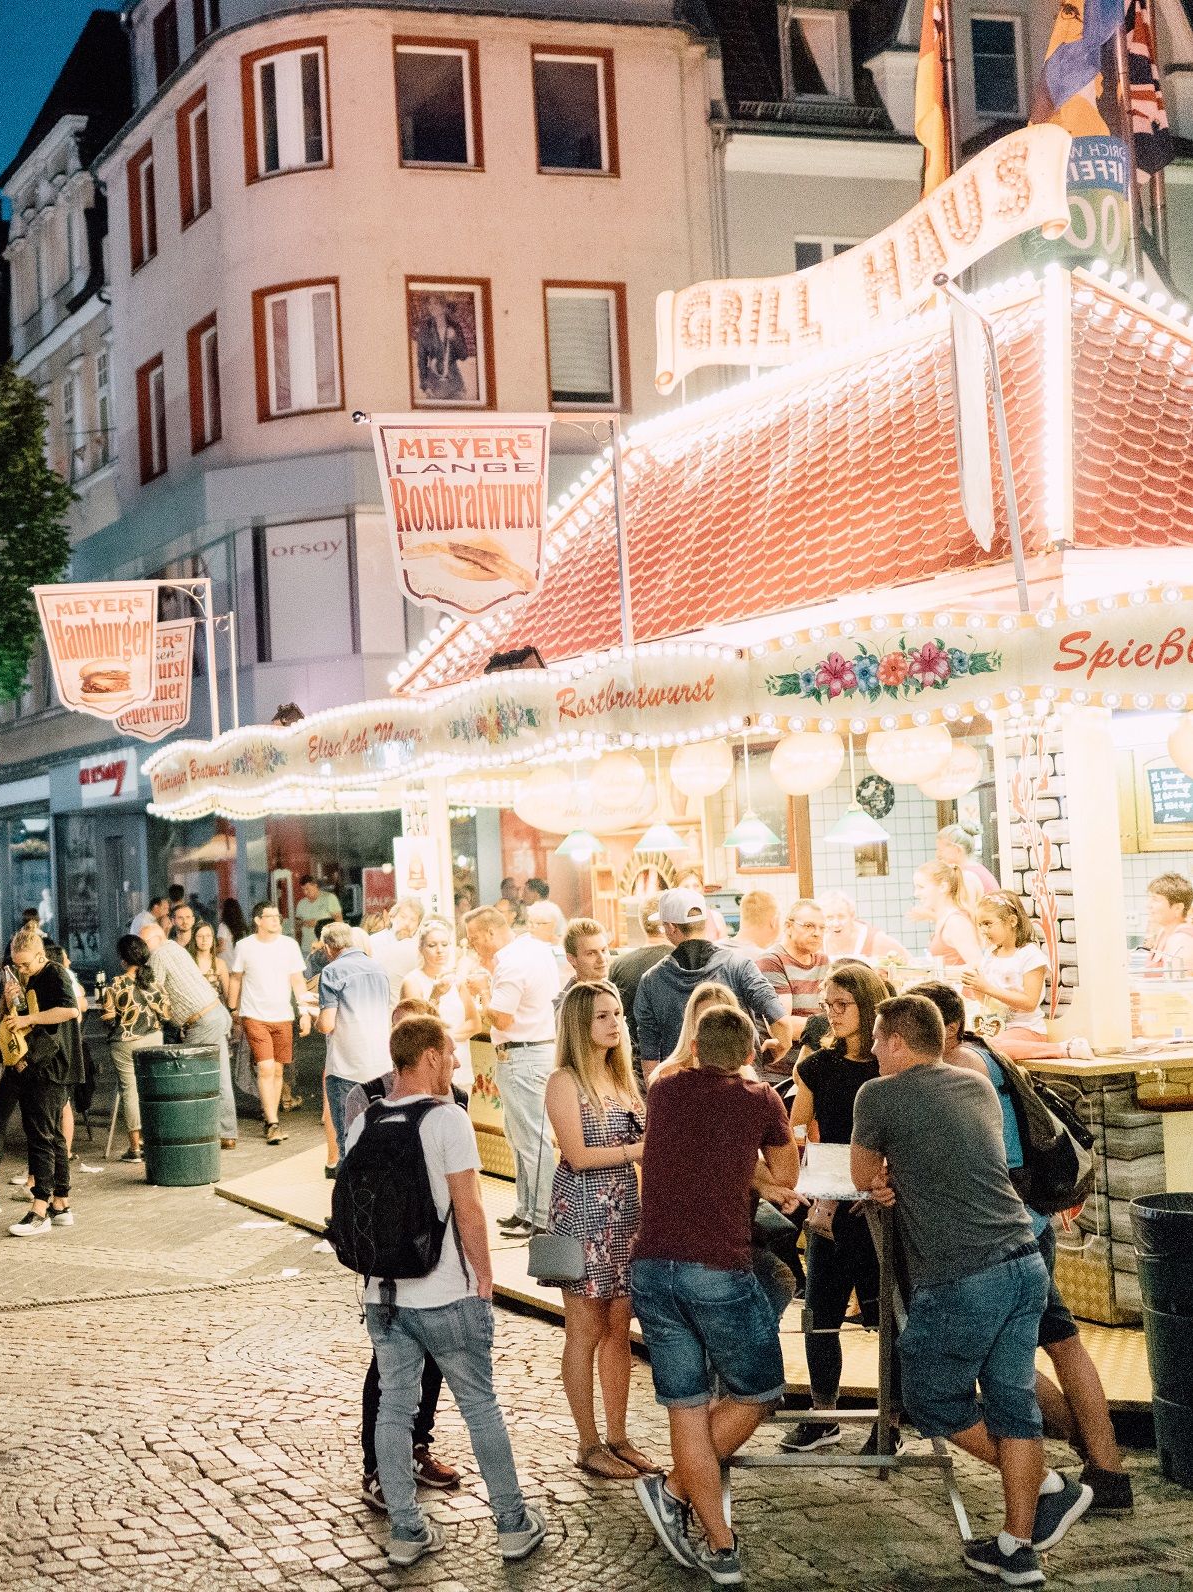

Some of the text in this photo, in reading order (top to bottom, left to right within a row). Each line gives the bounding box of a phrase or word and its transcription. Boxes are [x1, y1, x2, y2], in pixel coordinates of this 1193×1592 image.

[679, 139, 1032, 350] GRILL HAUS
[397, 433, 532, 460] MEYERS
[395, 462, 536, 474] LANGE
[389, 475, 543, 533] Rostbratwurst
[271, 540, 342, 560] orsay
[55, 597, 144, 618] MEYERS
[49, 615, 150, 661] Hamburger
[157, 657, 185, 680] urst
[555, 673, 716, 722] Rostbratwurst
[189, 758, 230, 781] Bratwurst
